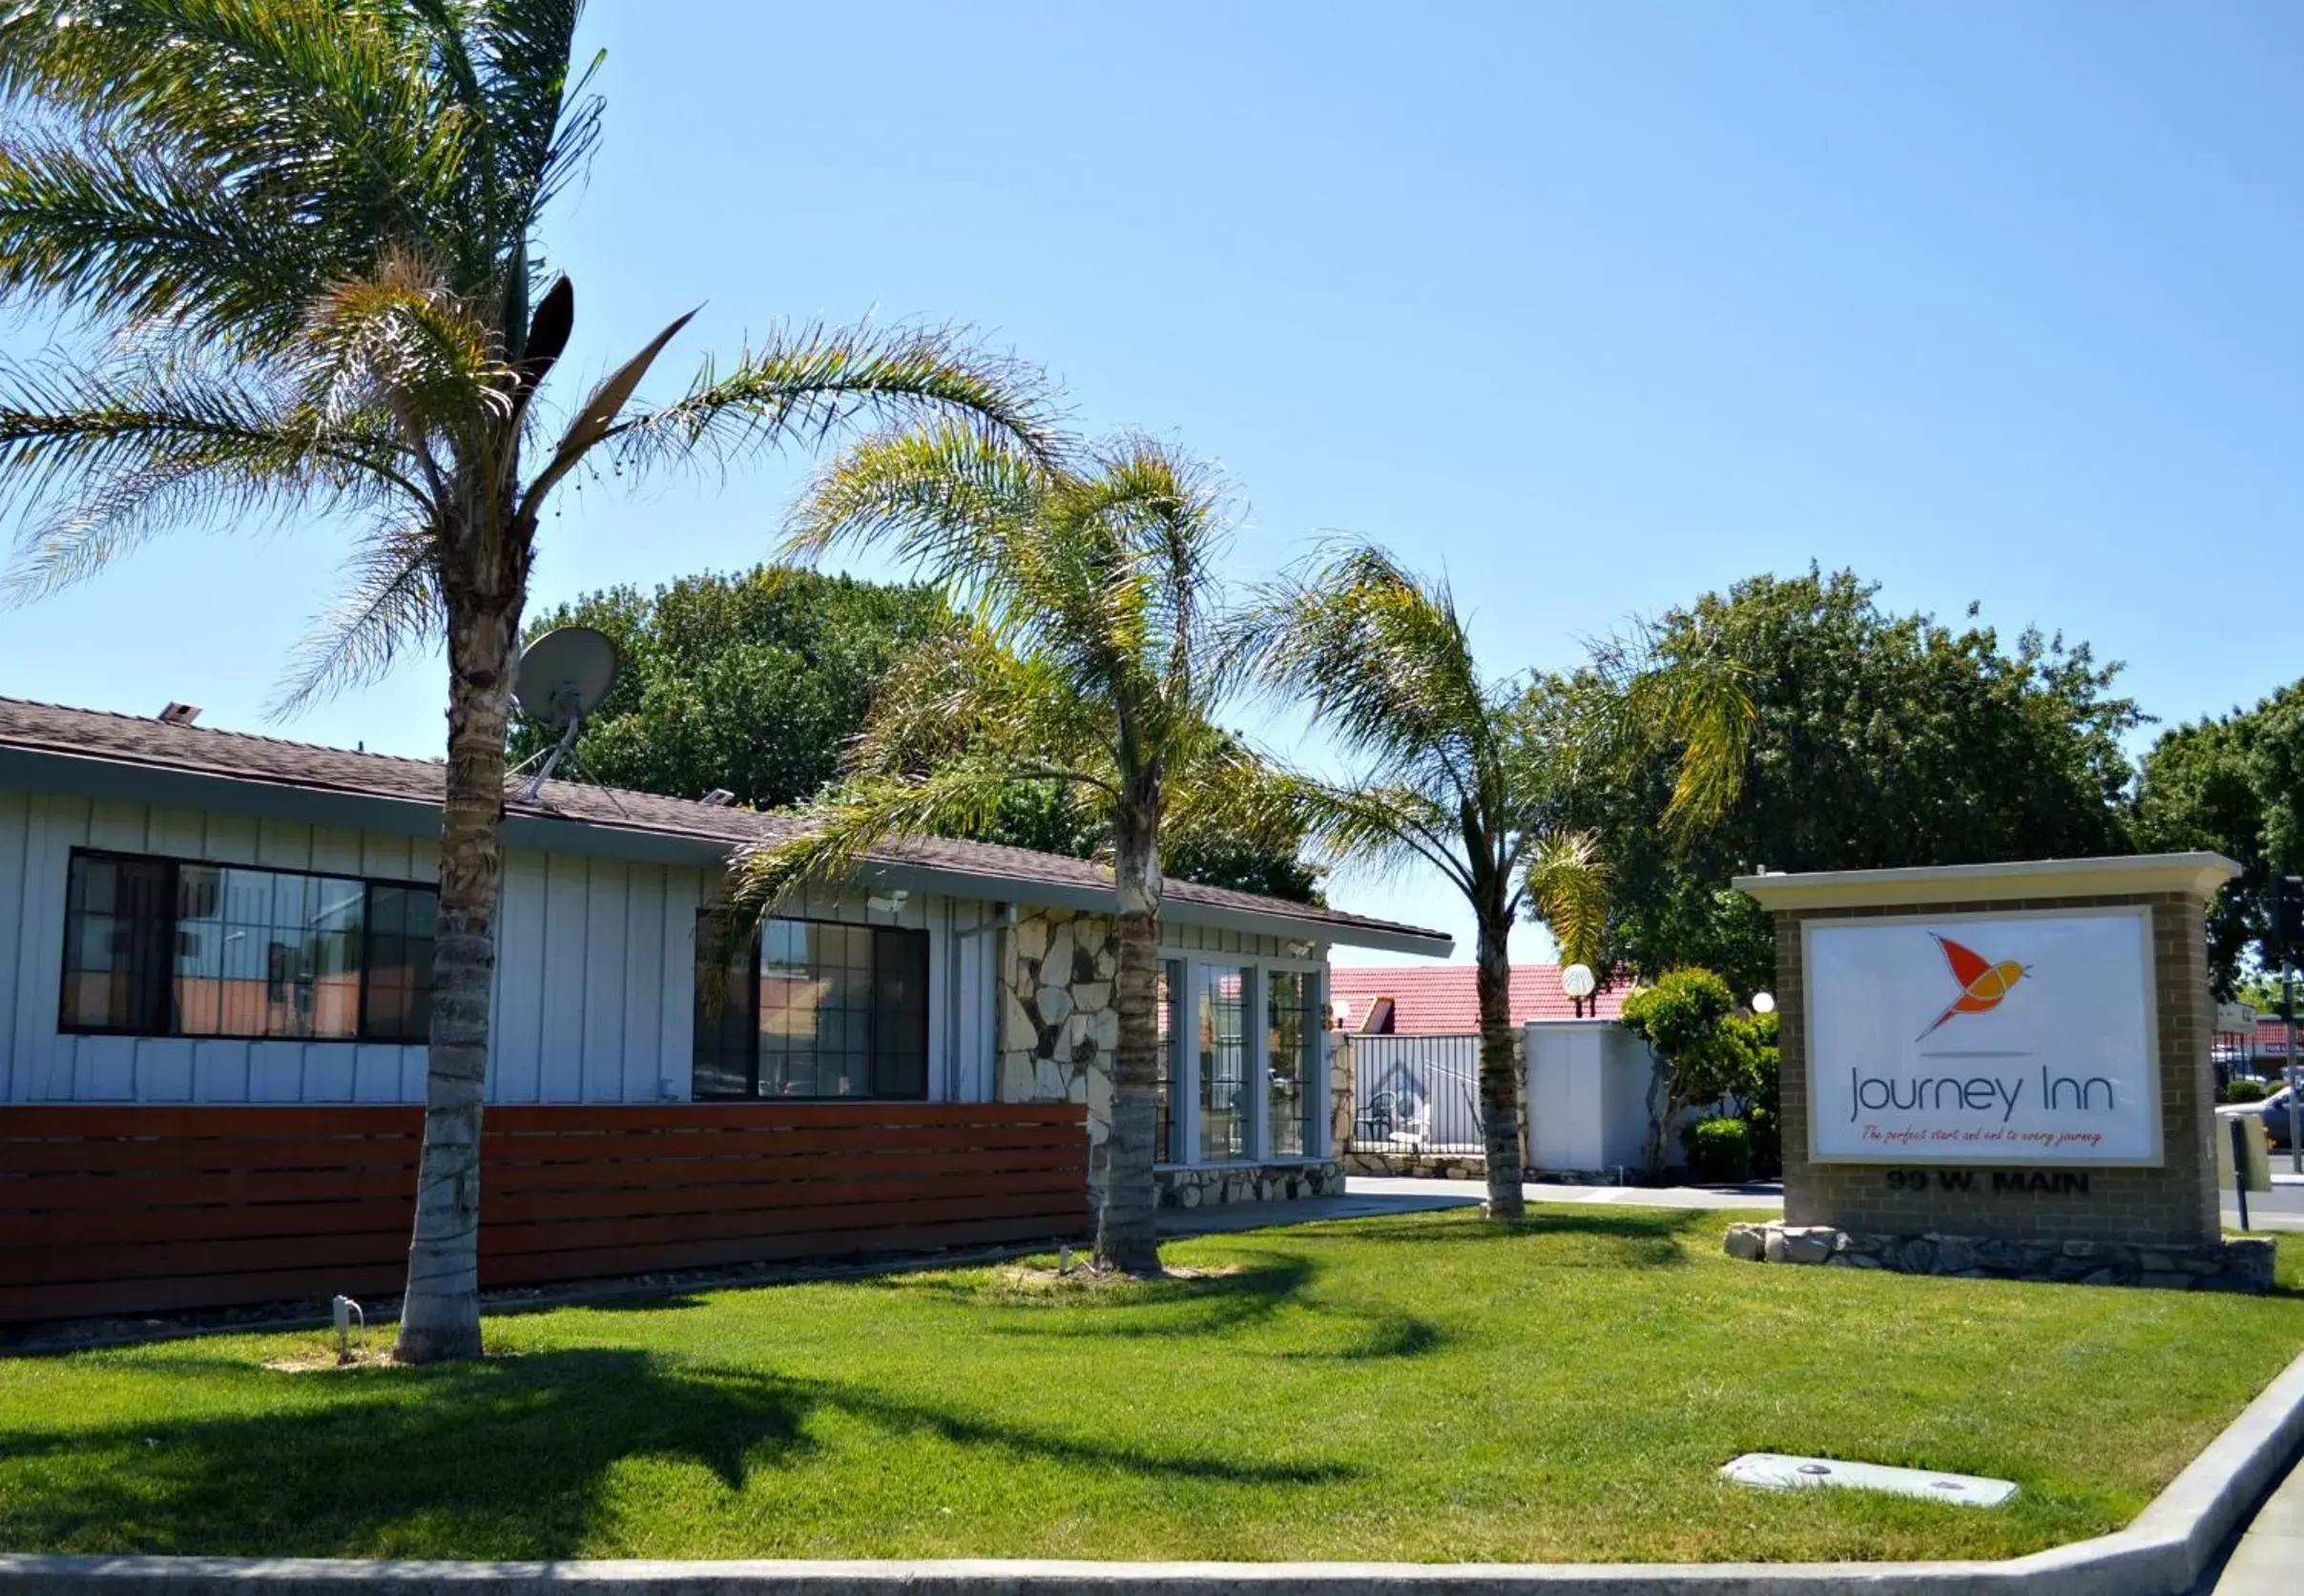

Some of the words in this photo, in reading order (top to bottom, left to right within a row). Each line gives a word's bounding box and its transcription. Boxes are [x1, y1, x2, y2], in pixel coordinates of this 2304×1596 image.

[1851, 1067, 2024, 1123] Journey
[2043, 1065, 2113, 1110] Inn
[1862, 1124, 1882, 1141] The
[1883, 1124, 1927, 1146] perfect
[1930, 1129, 1959, 1141] start
[2006, 1129, 2017, 1141] to
[2022, 1131, 2053, 1147] every
[2053, 1131, 2102, 1148] journey
[1885, 1170, 1928, 1192] 99
[1991, 1171, 2089, 1193] MAIN
